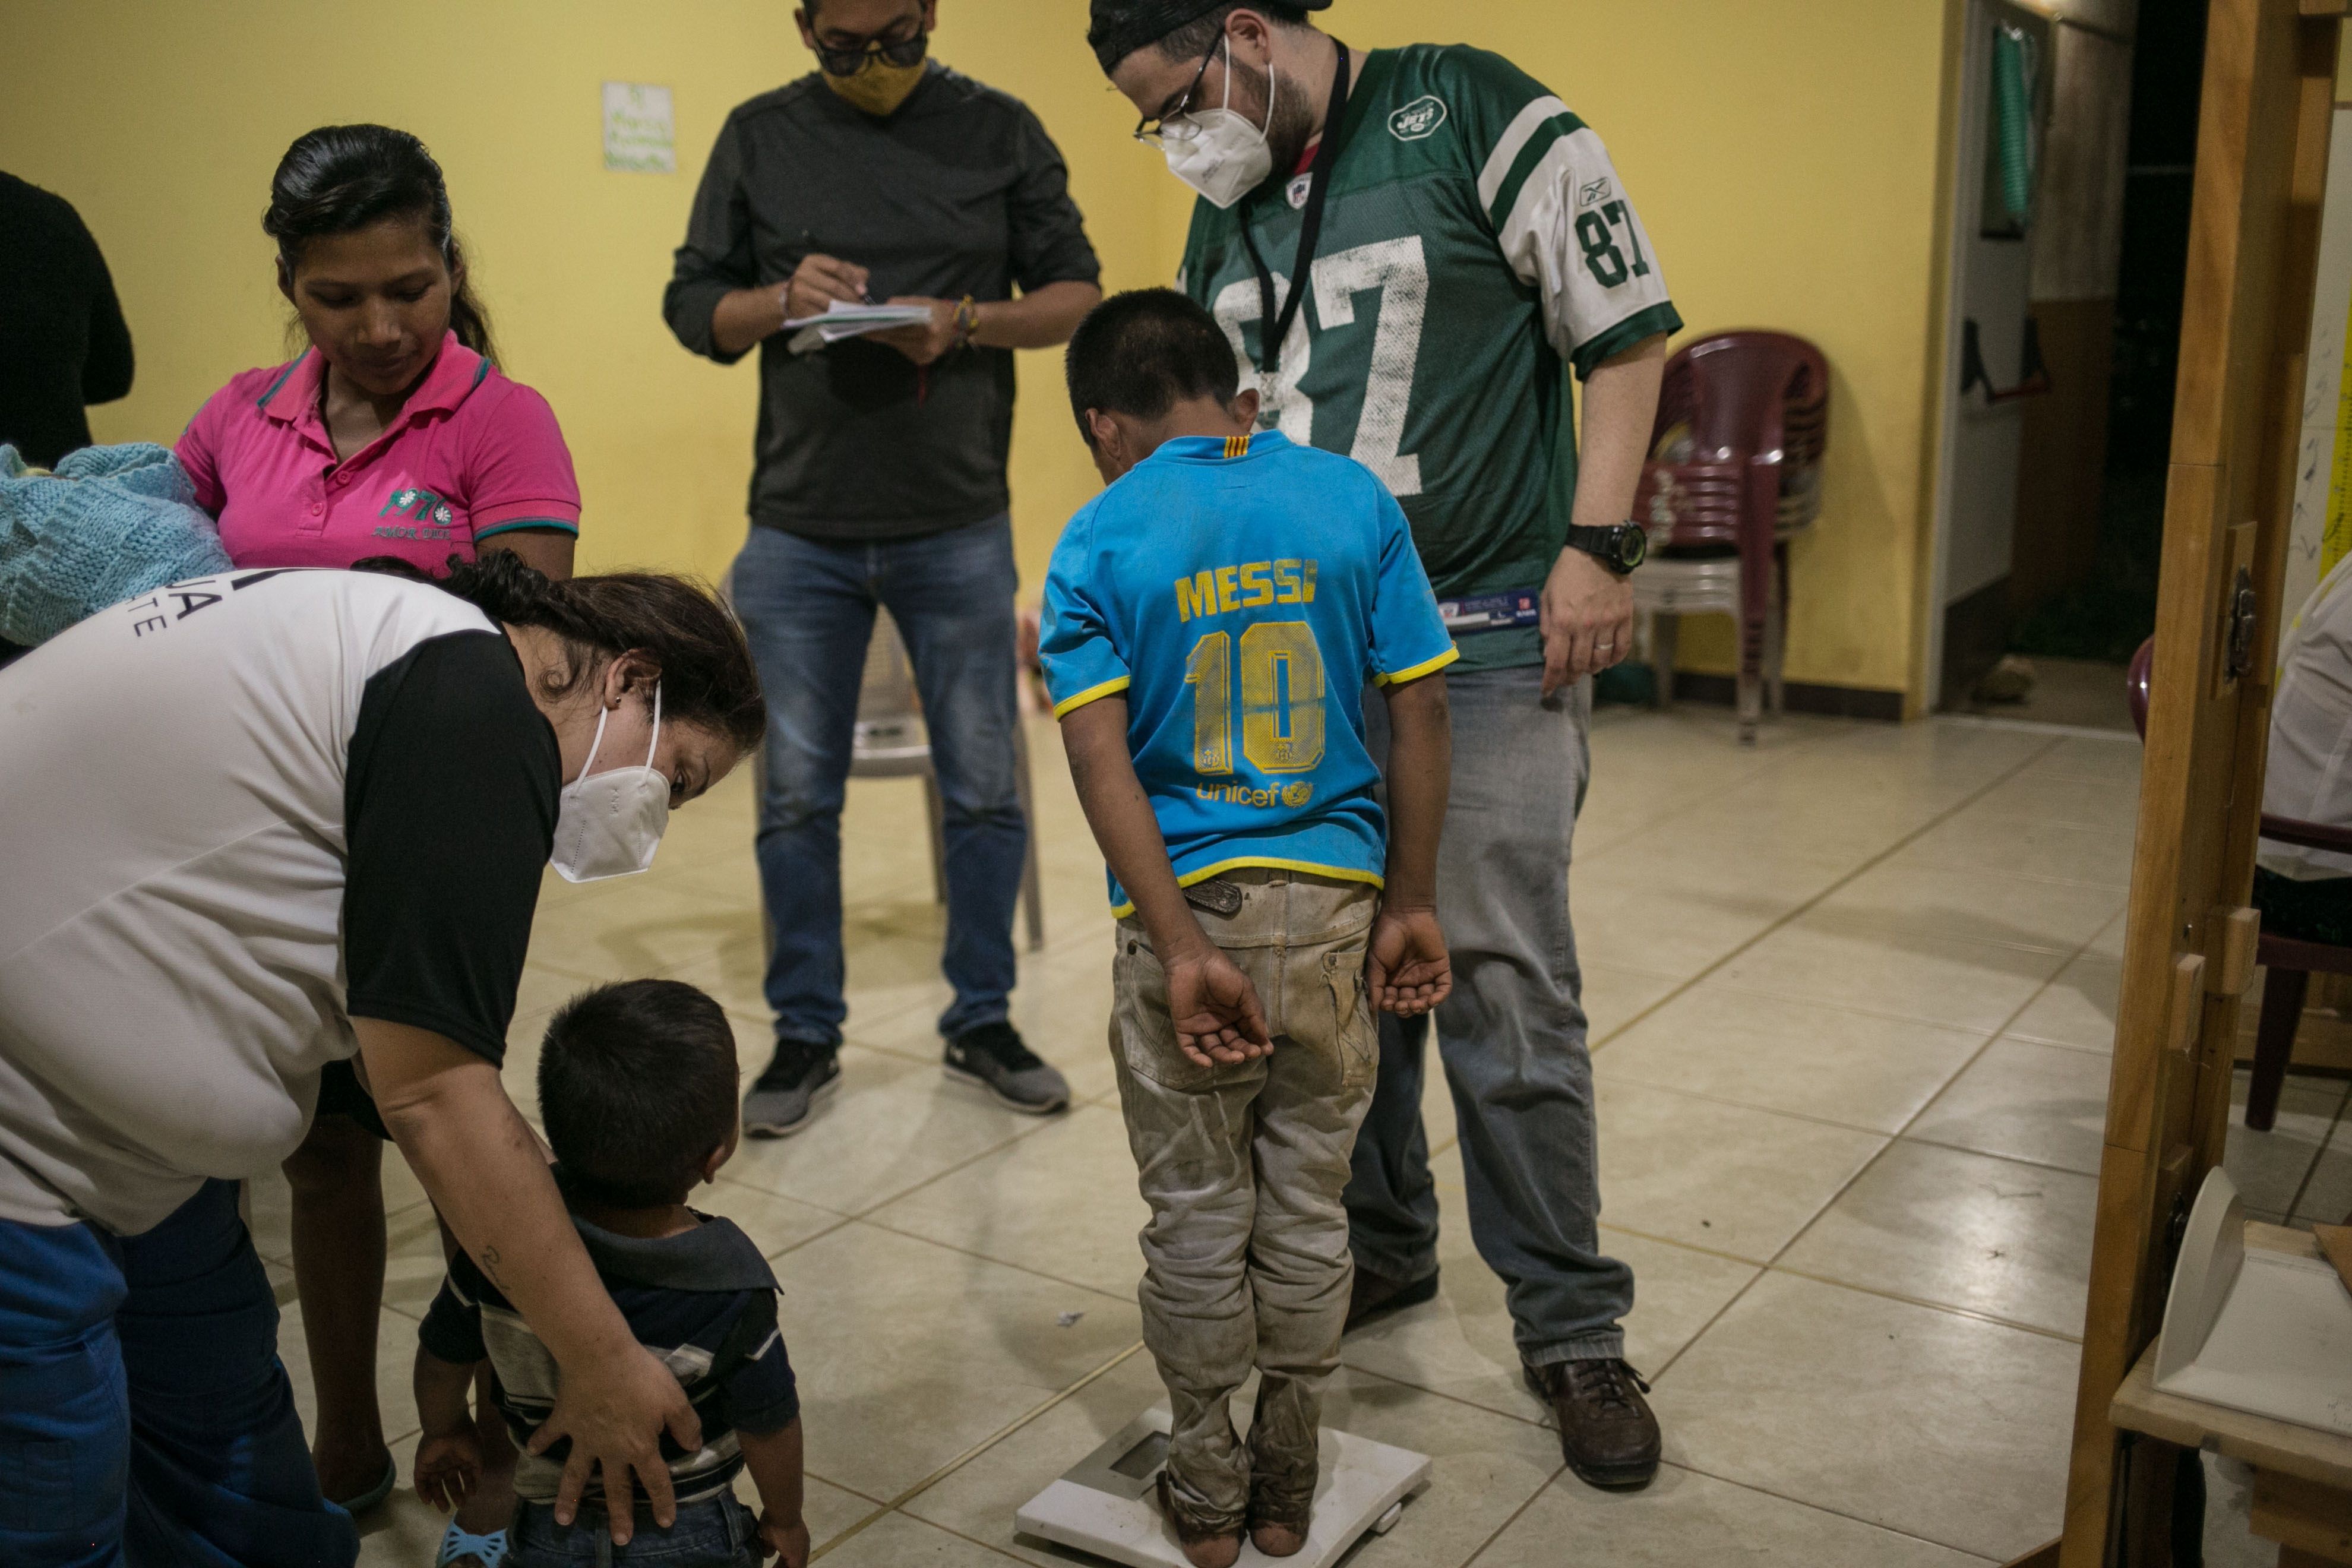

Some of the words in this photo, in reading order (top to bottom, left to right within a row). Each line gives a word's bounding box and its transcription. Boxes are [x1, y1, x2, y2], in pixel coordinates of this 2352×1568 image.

[1397, 108, 1434, 129] JETS
[1575, 200, 1651, 289] 87
[1213, 235, 1429, 496] 87
[1174, 558, 1318, 622] MESSI
[1184, 621, 1326, 776] 10
[1196, 780, 1279, 807] unicef
